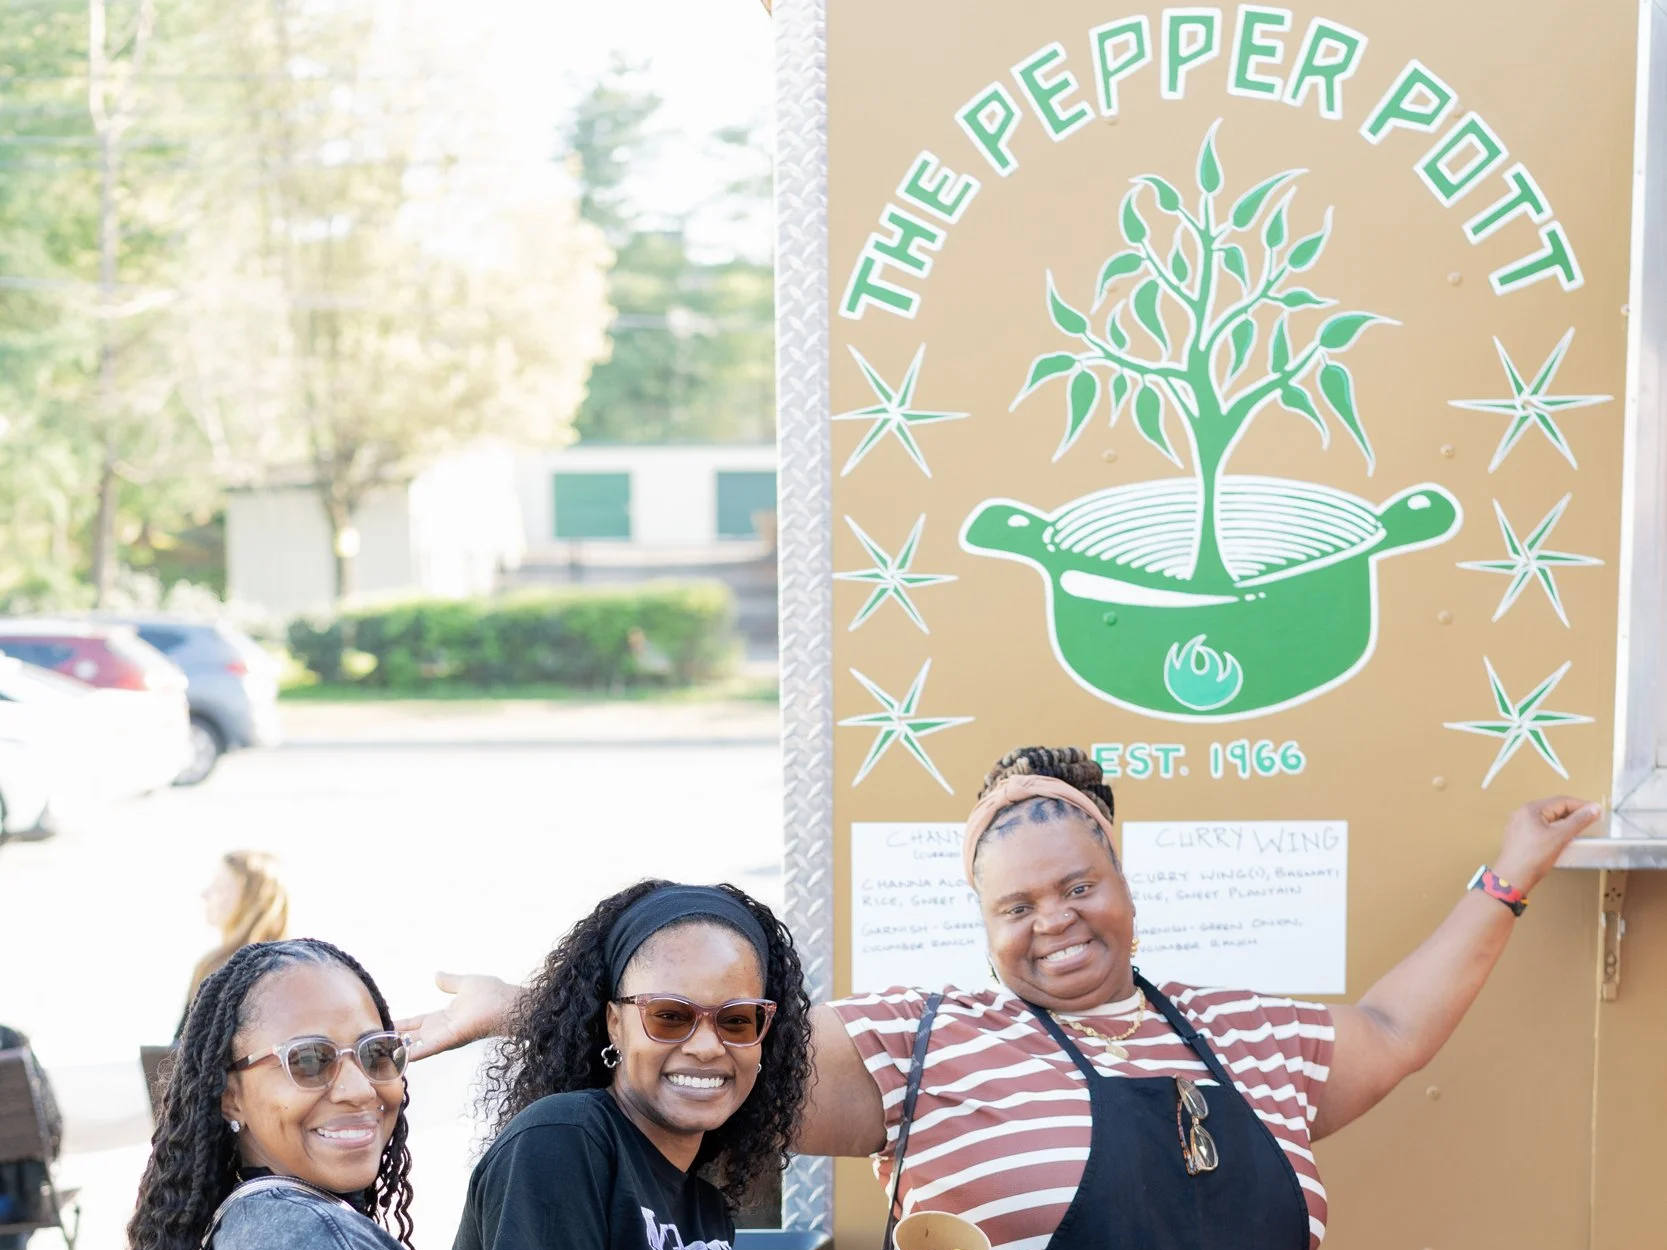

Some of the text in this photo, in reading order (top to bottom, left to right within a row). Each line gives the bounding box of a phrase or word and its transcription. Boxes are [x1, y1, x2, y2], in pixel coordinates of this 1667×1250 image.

[838, 3, 1585, 320] THE PEPPER POTT
[1091, 738, 1307, 779] EST. 1966
[1155, 825, 1340, 854] CURRY WING
[861, 878, 932, 891] CHANNA
[1130, 870, 1189, 884] CURRY
[909, 894, 957, 907] SWEET
[1176, 888, 1220, 901] SWEET
[1227, 885, 1302, 899] PLANTAIN
[861, 939, 975, 955] CUCUMBER RANCH
[1138, 937, 1257, 954] UCUMBER RANCH
